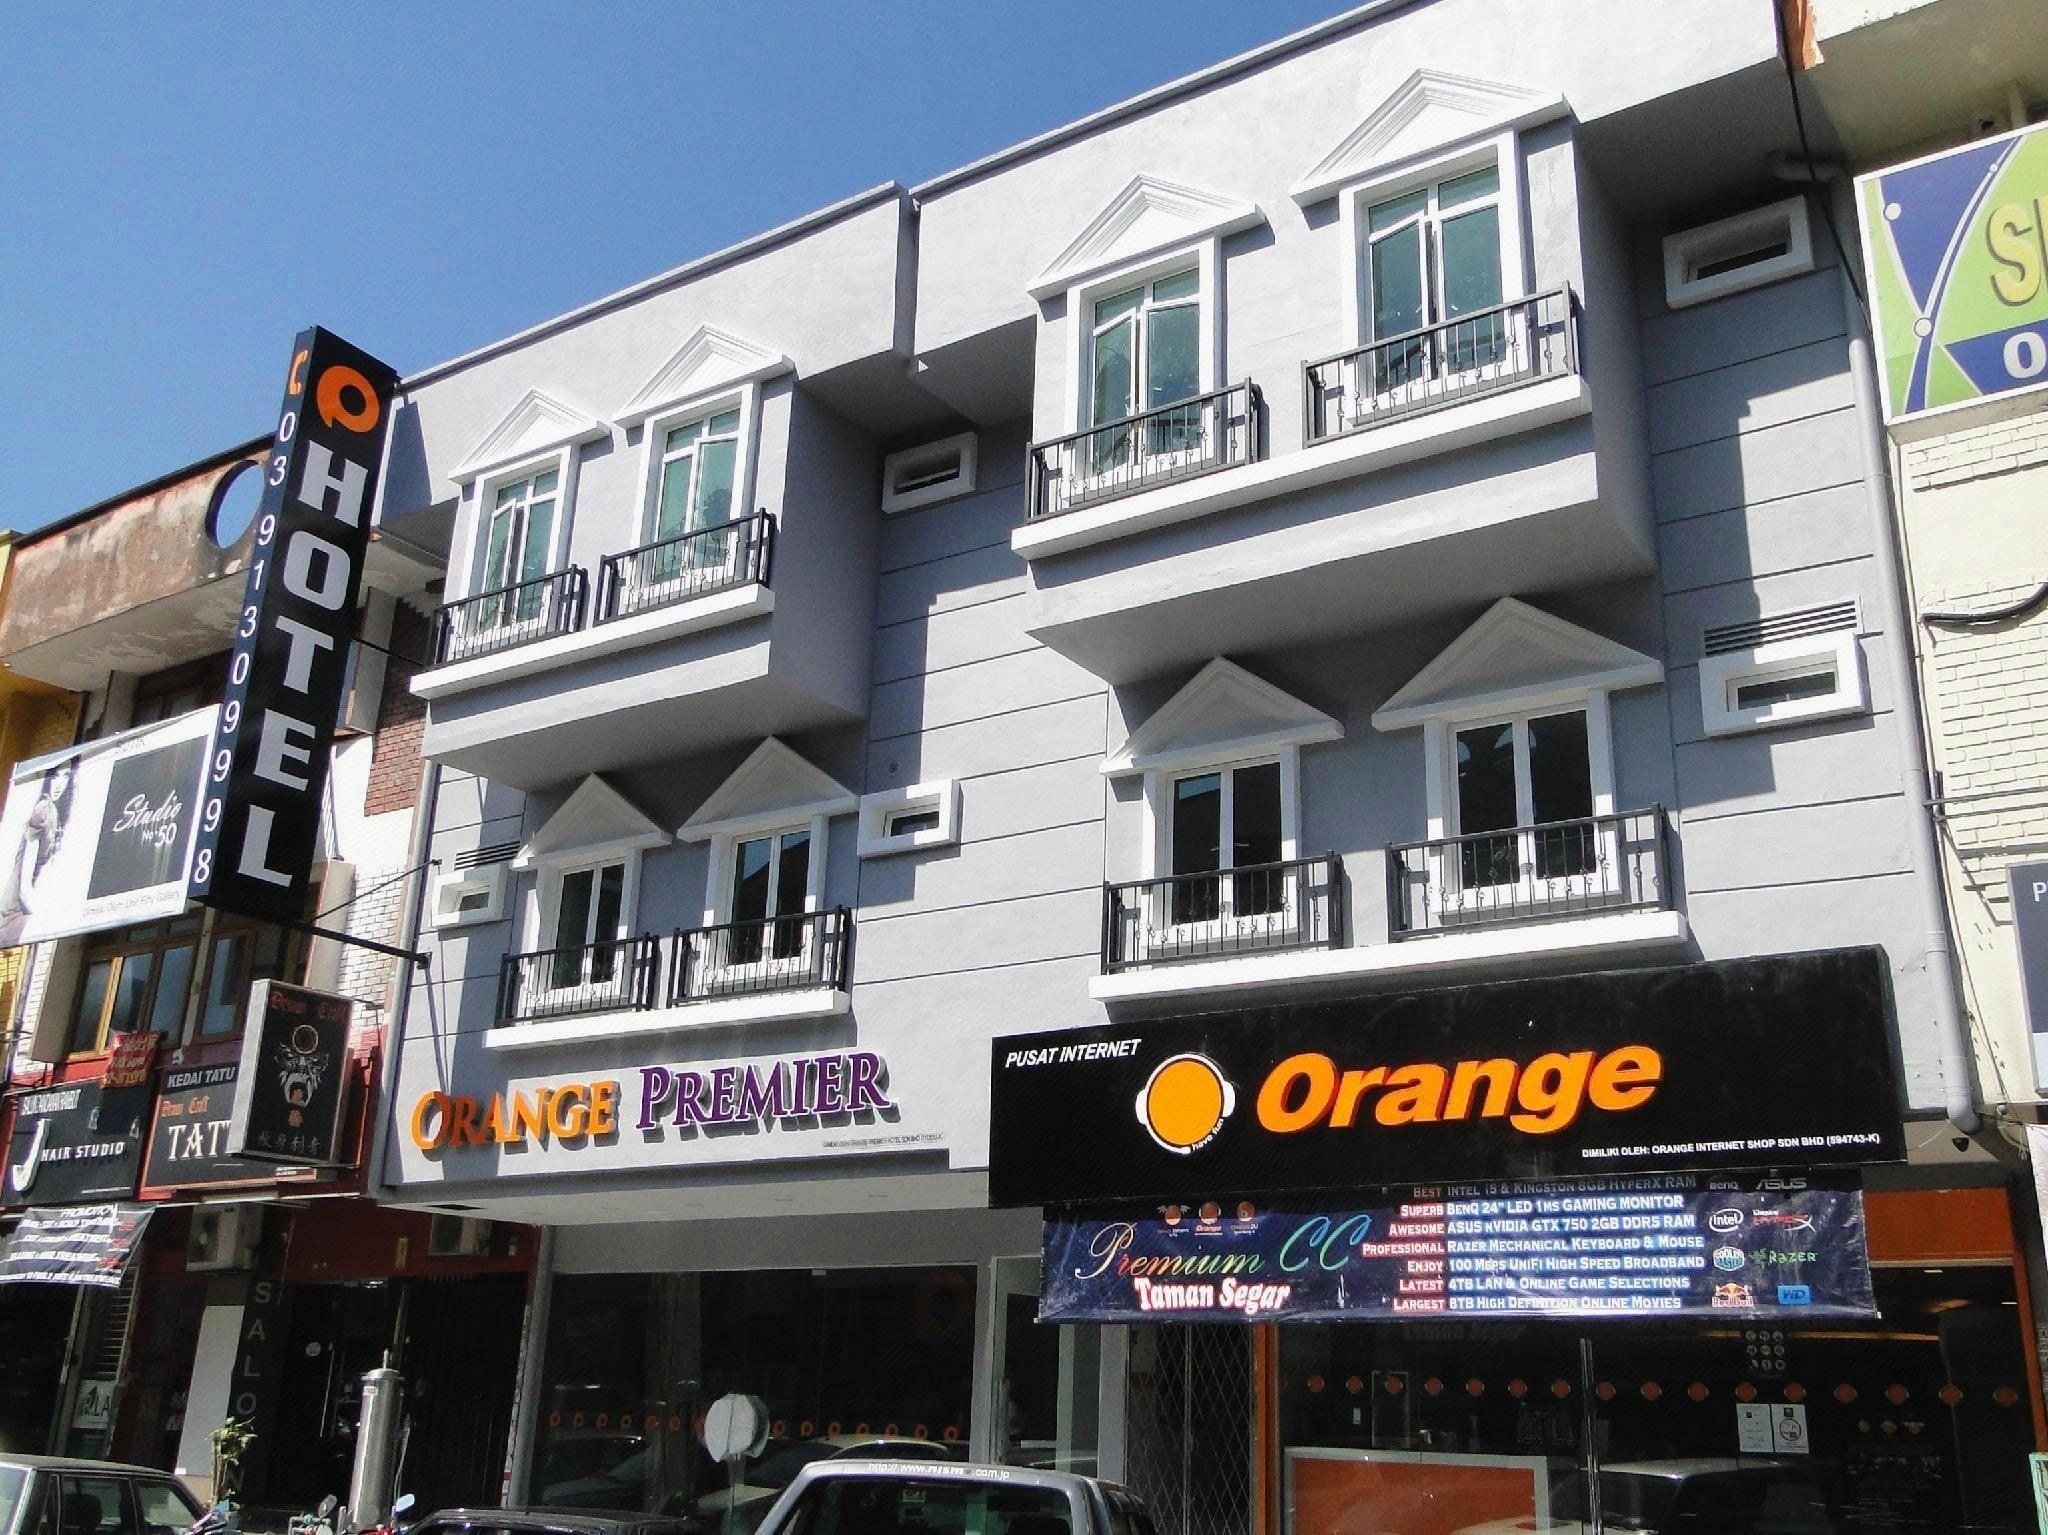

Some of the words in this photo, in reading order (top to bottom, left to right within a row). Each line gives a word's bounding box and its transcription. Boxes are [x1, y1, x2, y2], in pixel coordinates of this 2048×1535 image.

[237, 439, 369, 887] HOTEL
[113, 789, 182, 832] Studio
[1005, 1046, 1058, 1068] PUSAT
[1059, 1038, 1142, 1063] INTERNET
[167, 1070, 204, 1088] KEDAI
[205, 1066, 236, 1084] TATU
[410, 1080, 615, 1150] ORANGE
[635, 1051, 892, 1131] PREMIER
[1256, 1045, 1663, 1135] Orange
[1191, 1135, 1213, 1152] have
[1211, 1117, 1225, 1136] fun
[40, 1147, 71, 1162] HAIR
[74, 1141, 126, 1158] STUDIO
[1582, 1148, 1619, 1158] DIMILIKI
[1621, 1146, 1650, 1156] OLEH:
[1651, 1143, 1695, 1154] ORANGE
[1695, 1140, 1746, 1152] INTERNET
[1747, 1138, 1776, 1150] SHOP
[1778, 1137, 1799, 1148] SDN
[1801, 1135, 1825, 1146] BHD
[1500, 1183, 1511, 1194] &
[1578, 1180, 1606, 1191] 8GB
[1665, 1175, 1696, 1188] RAM
[1756, 1177, 1808, 1190] ASUS
[1507, 1200, 1533, 1213] LED
[1563, 1198, 1617, 1212] GAMING
[1619, 1195, 1684, 1209] MONITOR
[1447, 1221, 1482, 1233] ASUS
[1531, 1217, 1560, 1231] GTX
[1562, 1218, 1588, 1230] 750
[1591, 1217, 1619, 1230] 2GB
[1622, 1215, 1660, 1229] DDR5
[1664, 1214, 1695, 1228] RAM
[1074, 1220, 1266, 1280] Premium
[1279, 1214, 1373, 1272] CC
[1643, 1236, 1654, 1248] &
[1449, 1259, 1472, 1270] 100
[1448, 1278, 1473, 1290] 4TB
[1476, 1278, 1503, 1290] LAN
[1133, 1277, 1214, 1310] Taman
[1218, 1277, 1291, 1315] Segar
[1449, 1297, 1474, 1310] 8TB
